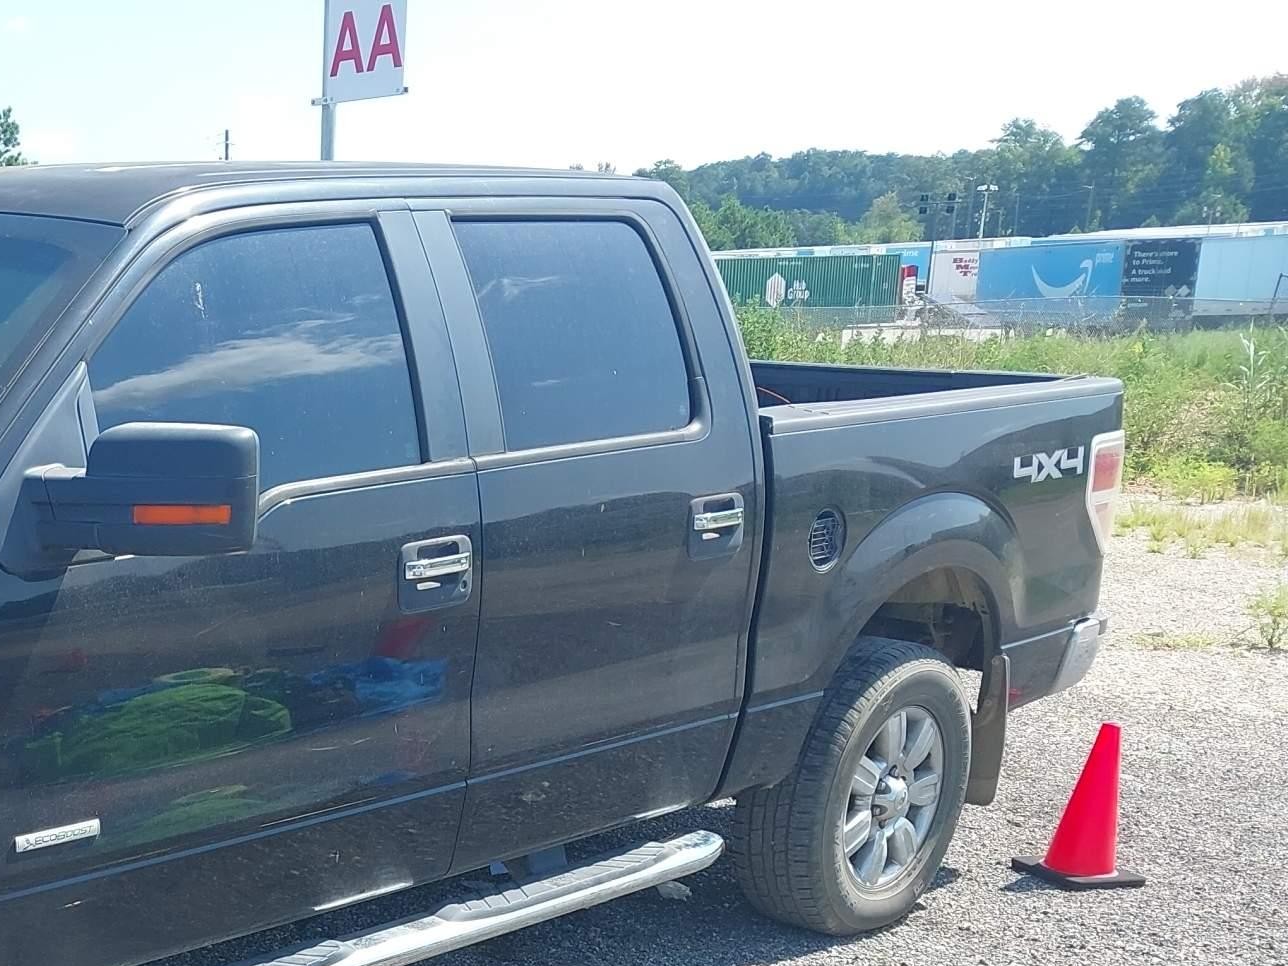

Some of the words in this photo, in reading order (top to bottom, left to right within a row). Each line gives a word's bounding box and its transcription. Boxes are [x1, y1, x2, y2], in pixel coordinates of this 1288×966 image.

[329, 3, 403, 78] AA
[793, 279, 806, 290] Hub
[787, 287, 810, 301] Group
